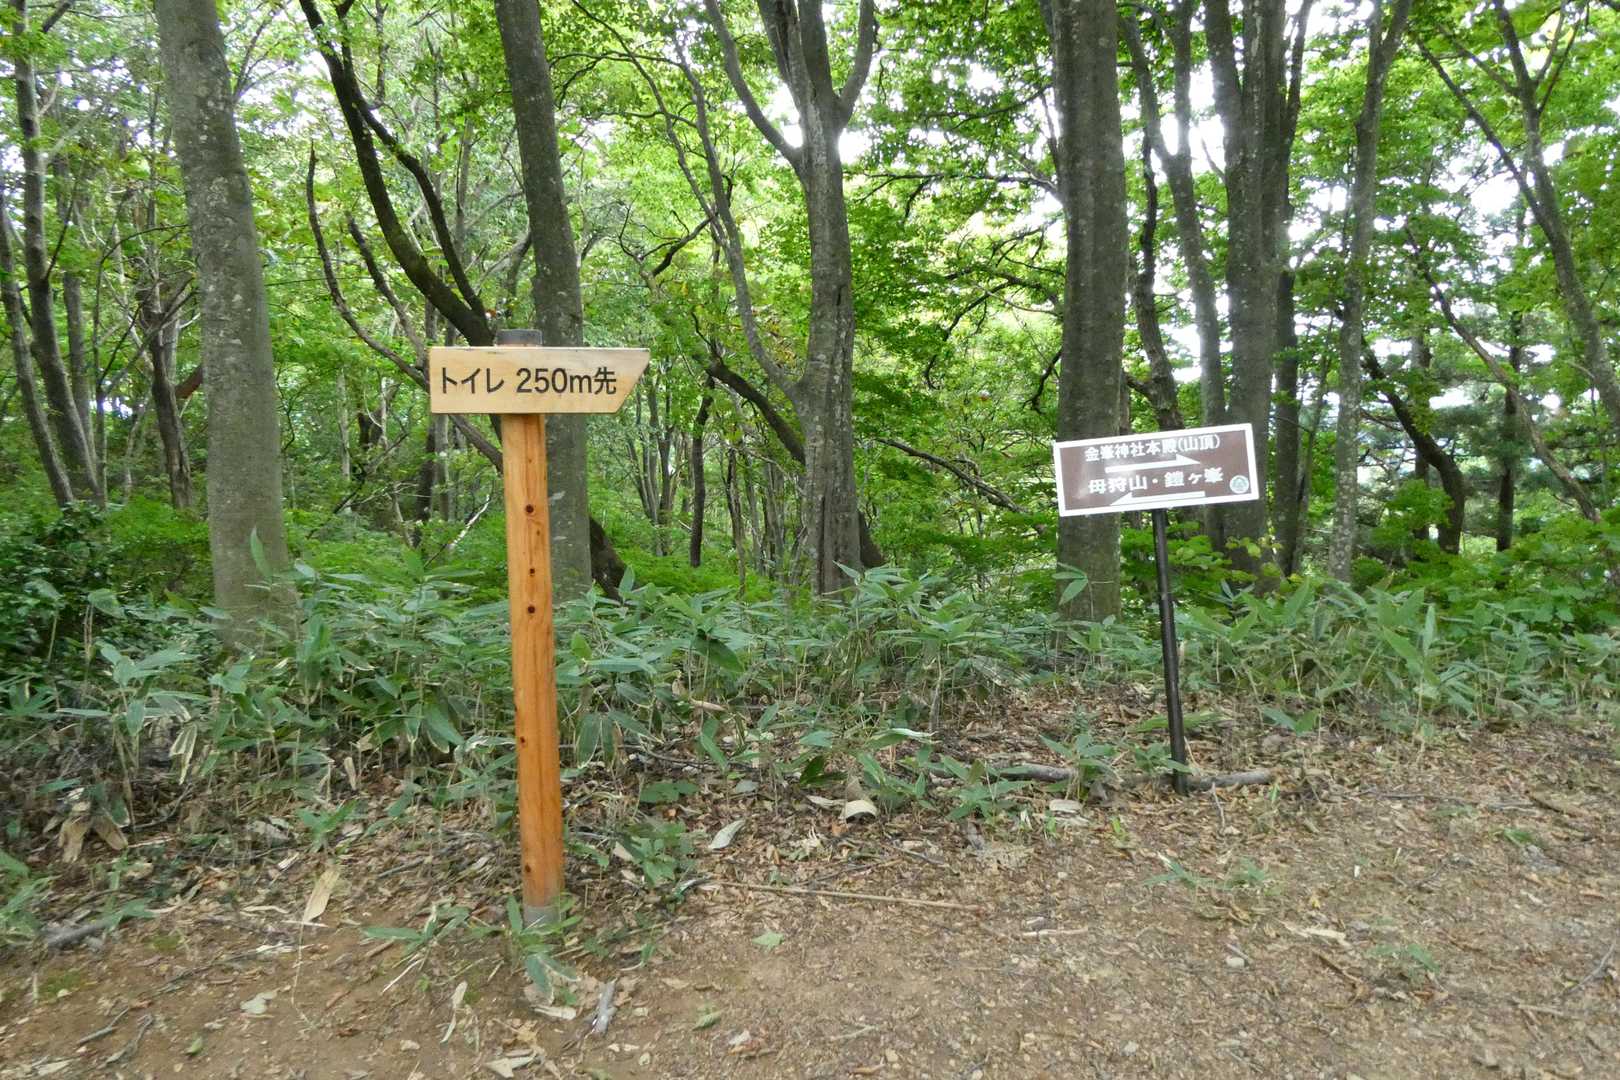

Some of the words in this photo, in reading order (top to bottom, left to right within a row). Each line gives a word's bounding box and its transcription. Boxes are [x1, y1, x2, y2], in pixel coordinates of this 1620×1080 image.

[442, 367, 504, 394] トイレ
[516, 367, 617, 395] 250m先
